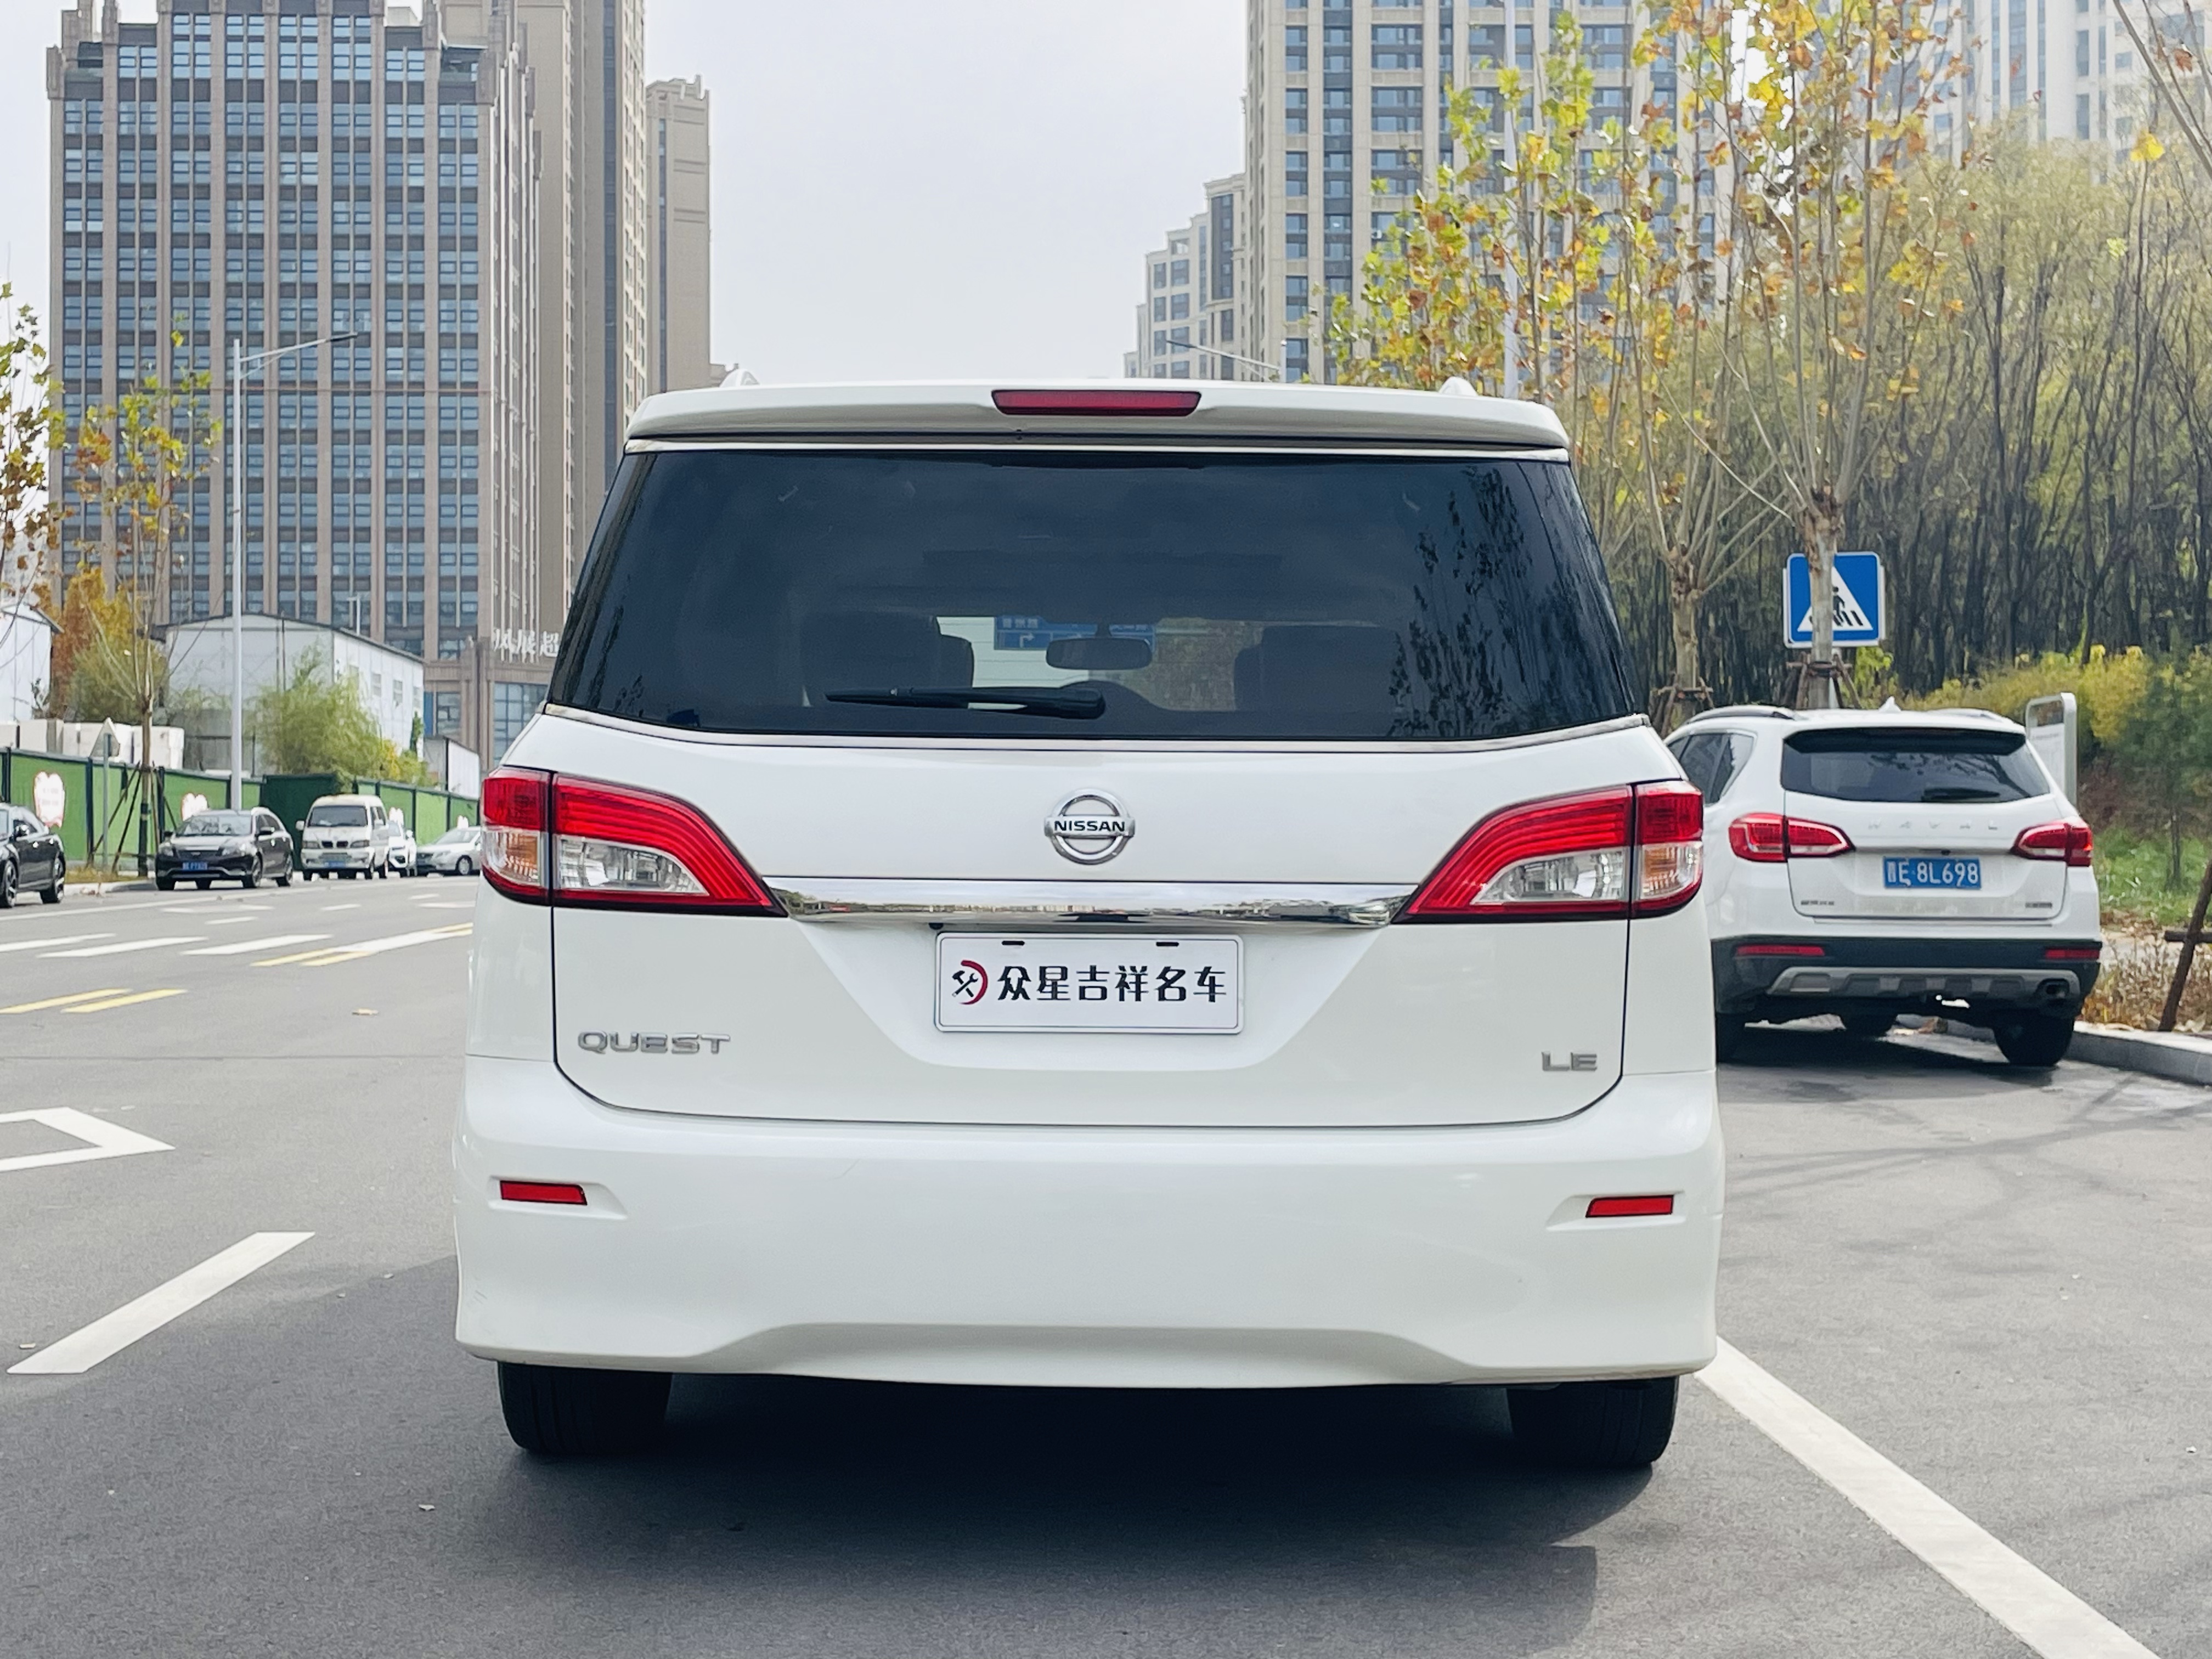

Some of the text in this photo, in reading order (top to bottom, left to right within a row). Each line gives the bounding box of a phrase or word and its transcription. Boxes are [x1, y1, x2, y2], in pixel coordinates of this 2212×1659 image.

[1054, 820, 1125, 832] NISSAN
[997, 964, 1227, 1003] 众星吉祥名车
[578, 1030, 731, 1054] QUEST
[1541, 1052, 1597, 1071] LE
